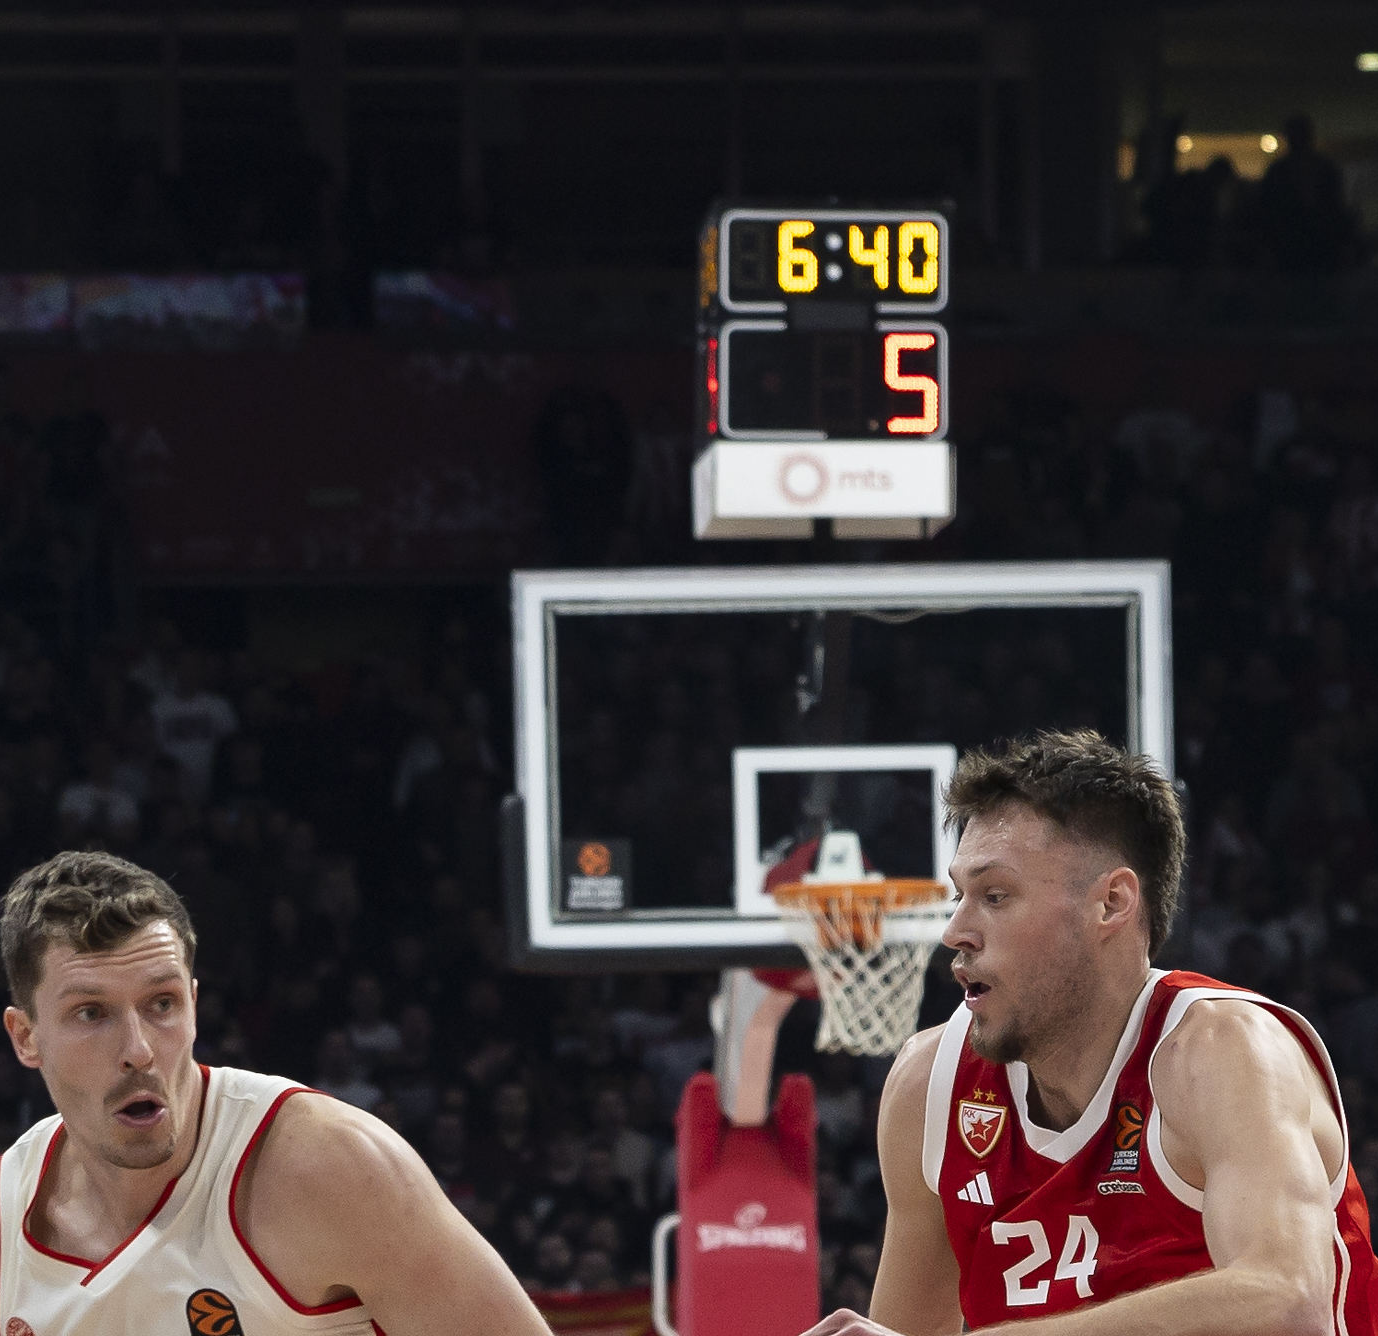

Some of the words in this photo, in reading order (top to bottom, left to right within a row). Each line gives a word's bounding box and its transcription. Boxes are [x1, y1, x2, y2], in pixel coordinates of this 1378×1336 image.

[778, 220, 939, 293] 6:40
[884, 332, 939, 434] 5
[991, 1215, 1099, 1307] 24
